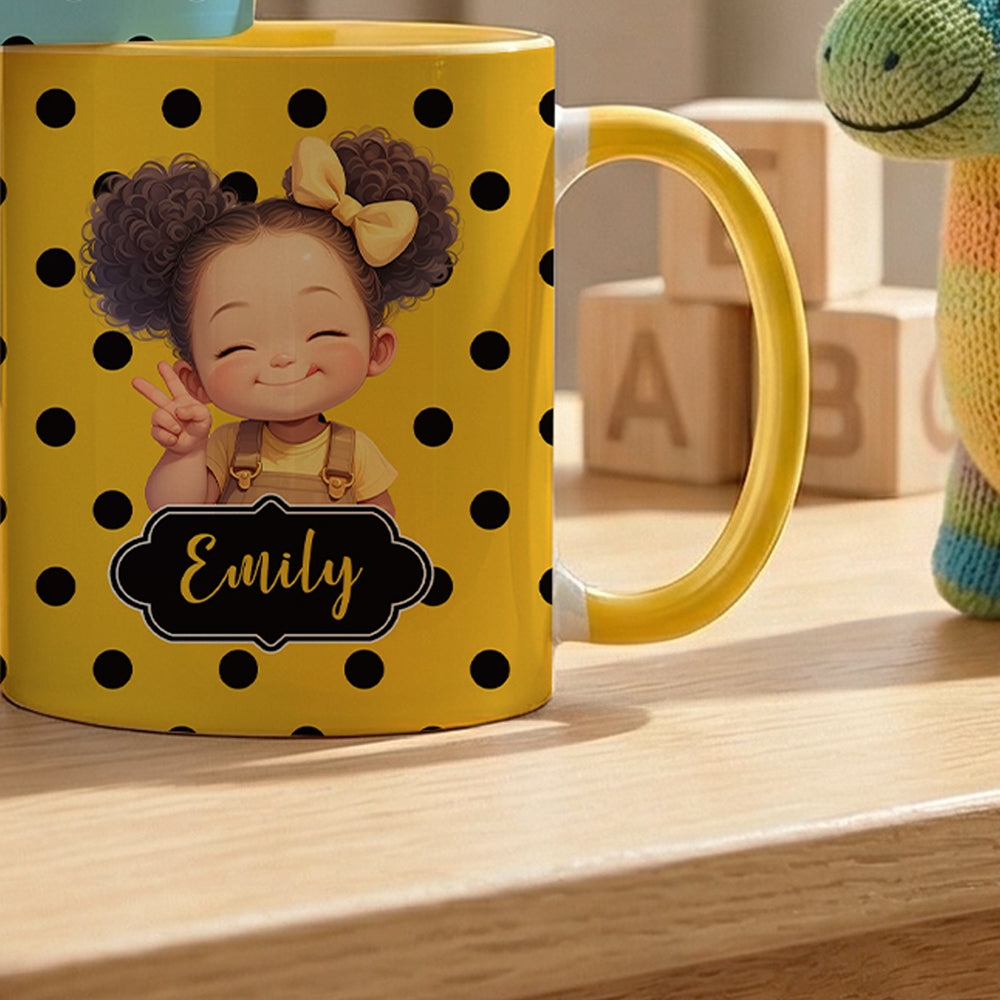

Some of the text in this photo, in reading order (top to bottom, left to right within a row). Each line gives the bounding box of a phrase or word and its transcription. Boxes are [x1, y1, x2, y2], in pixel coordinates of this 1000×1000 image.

[605, 328, 688, 449] A
[806, 342, 865, 458] B
[180, 528, 364, 621] Emily
